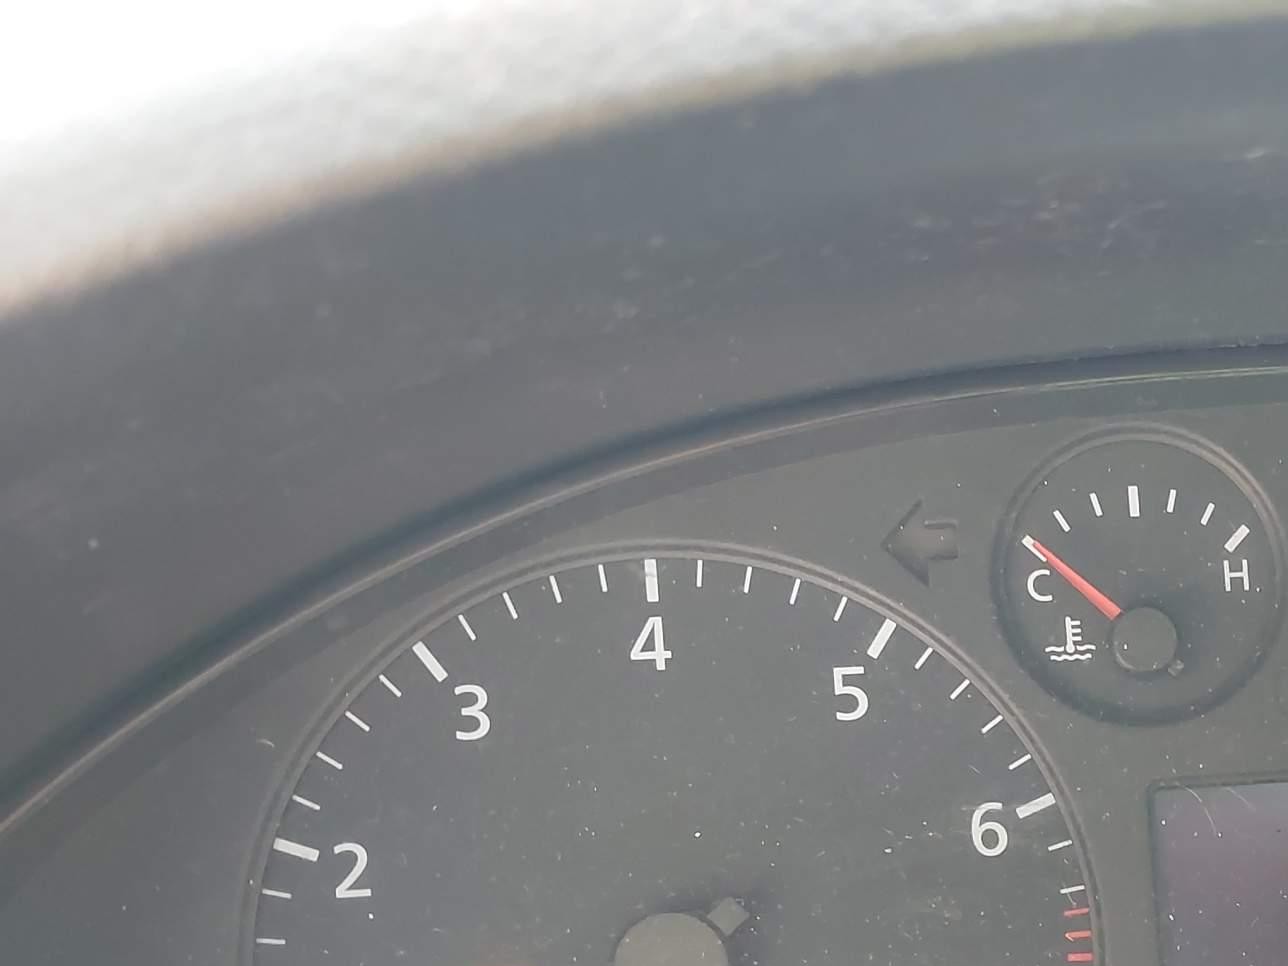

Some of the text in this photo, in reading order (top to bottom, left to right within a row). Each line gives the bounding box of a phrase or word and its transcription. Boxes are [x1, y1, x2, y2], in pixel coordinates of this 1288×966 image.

[1026, 569, 1053, 602] C
[1222, 560, 1250, 592] H
[629, 617, 672, 671] 4
[453, 685, 492, 742] 3
[833, 666, 869, 721] 5
[970, 803, 1008, 856] 6
[332, 845, 372, 899] 2
